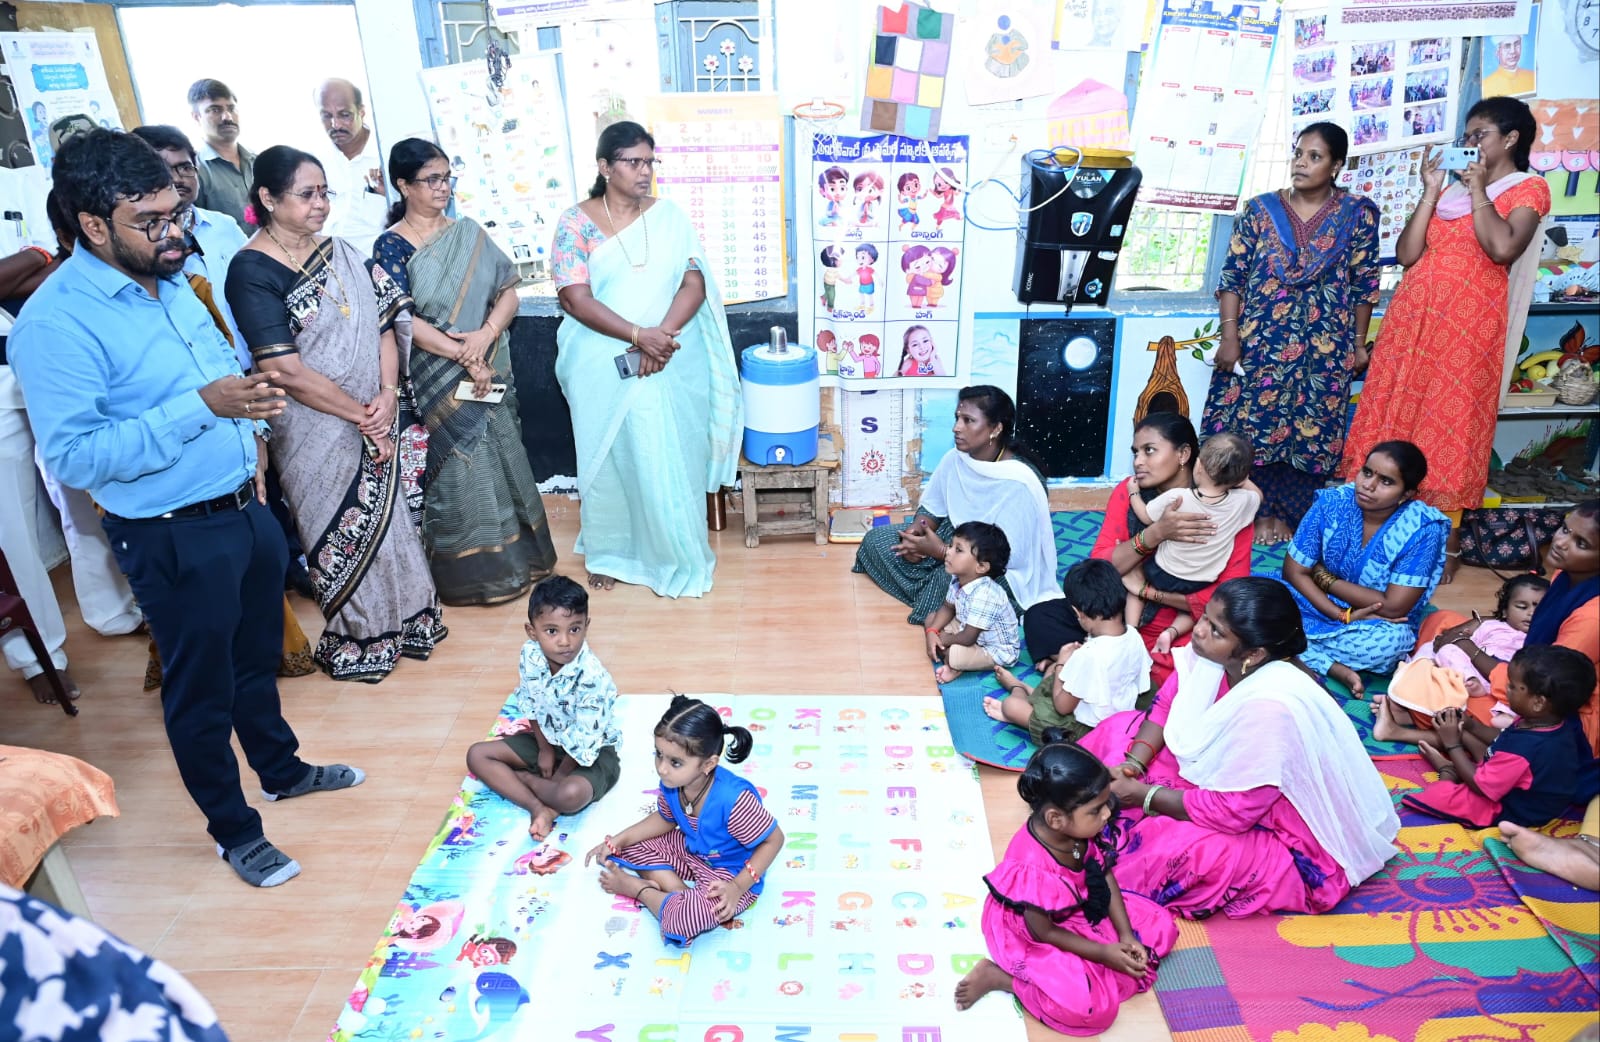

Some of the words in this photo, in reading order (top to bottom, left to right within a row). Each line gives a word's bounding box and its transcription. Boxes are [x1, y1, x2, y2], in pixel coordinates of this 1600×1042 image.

[1584, 16, 1590, 26] 8
[1592, 28, 1599, 38] 7
[680, 124, 688, 133] 2
[705, 123, 712, 133] 3
[729, 122, 737, 133] 4
[681, 154, 688, 164] 7
[706, 155, 713, 164] 8
[732, 154, 738, 164] 9
[758, 154, 772, 162] 10
[690, 186, 703, 194] 21
[721, 186, 734, 194] 31
[691, 210, 704, 218] 23
[754, 256, 766, 264] 47
[861, 416, 878, 434] S
[749, 708, 776, 720] O
[795, 708, 822, 720] K
[838, 708, 866, 720] G
[881, 708, 910, 720] C
[921, 708, 946, 719] A
[792, 745, 821, 756] L
[839, 745, 868, 758] H
[885, 746, 913, 758] D
[926, 746, 954, 758] B
[790, 784, 818, 800] M
[887, 786, 916, 798] E
[786, 832, 818, 850] N
[838, 834, 870, 848] J
[890, 838, 922, 852] F
[782, 890, 816, 908] K
[838, 892, 874, 910] G
[892, 892, 928, 910] C
[942, 892, 976, 909] A
[594, 952, 632, 970] X
[656, 952, 692, 974] T
[718, 950, 752, 972] P
[778, 953, 814, 970] L
[838, 953, 876, 974] H
[898, 954, 934, 976] D
[951, 954, 986, 974] B
